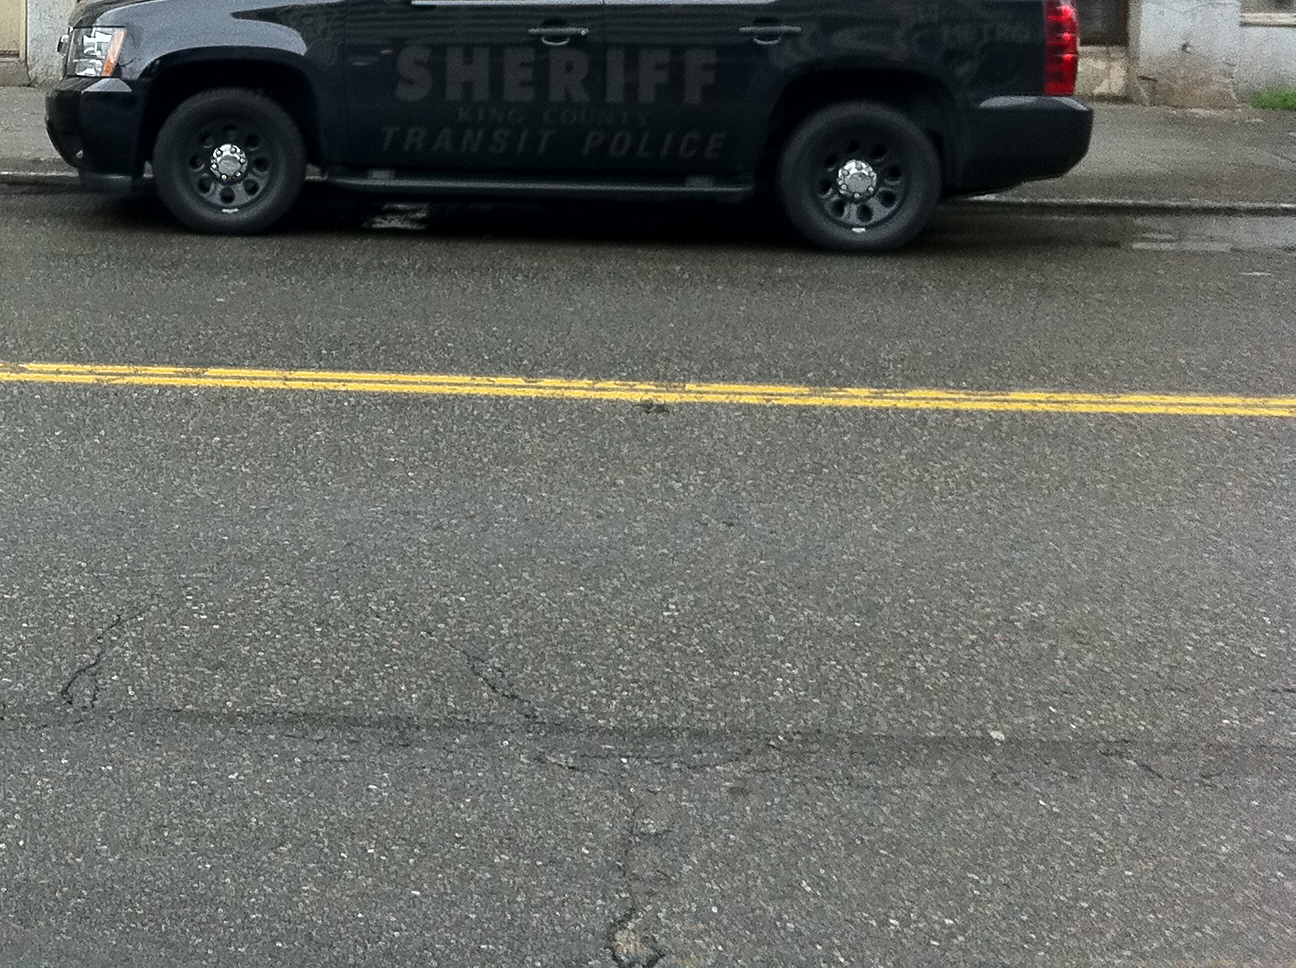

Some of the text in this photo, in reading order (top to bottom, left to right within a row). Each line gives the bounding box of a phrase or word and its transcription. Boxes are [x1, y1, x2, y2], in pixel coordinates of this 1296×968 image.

[394, 46, 718, 105] SHERIFF
[456, 107, 652, 127] KING COUNTY
[380, 125, 728, 161] TRANSIT POLICE
